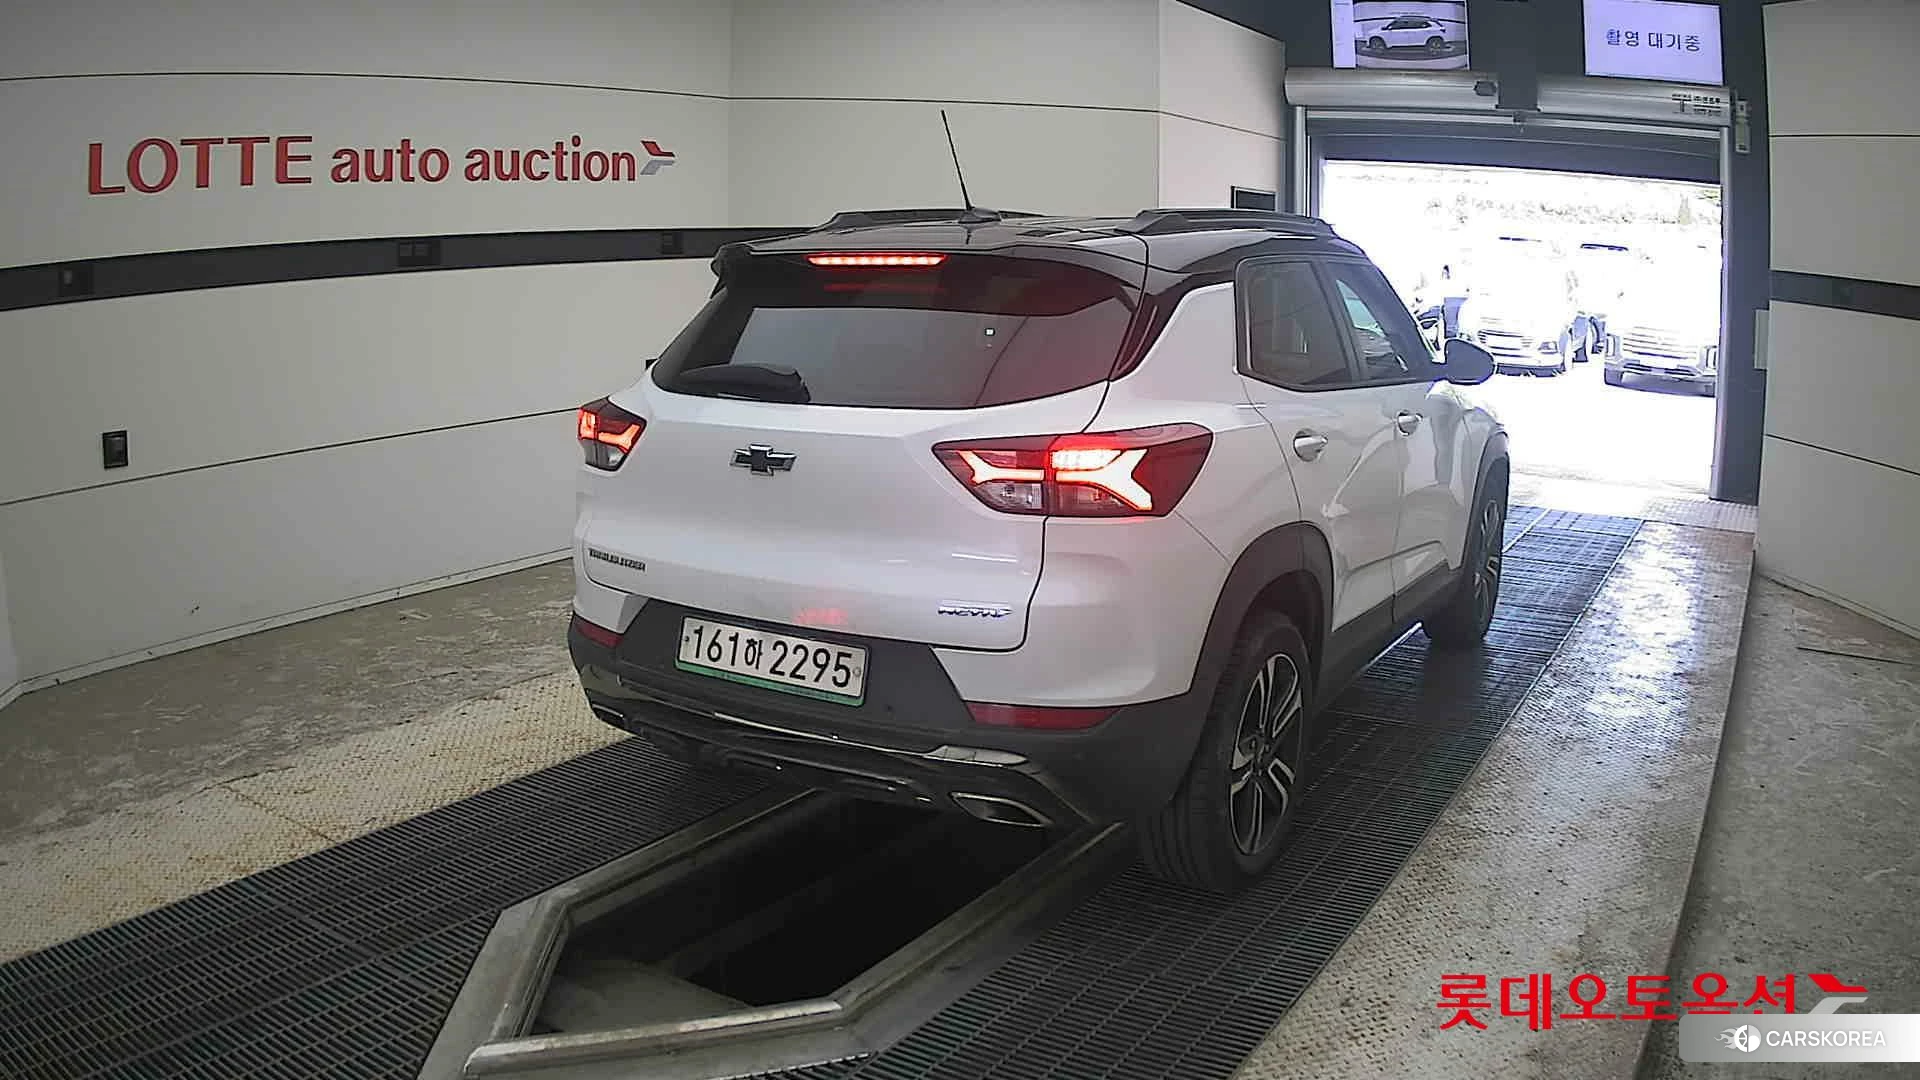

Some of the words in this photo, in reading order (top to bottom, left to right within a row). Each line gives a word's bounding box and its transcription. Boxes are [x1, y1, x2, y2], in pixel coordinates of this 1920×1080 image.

[1647, 32, 1700, 51] 대기중
[88, 135, 313, 195] LOTTE
[330, 138, 454, 183] auto
[464, 135, 636, 182] auction
[693, 625, 763, 670] 161하
[769, 640, 853, 688] 2295
